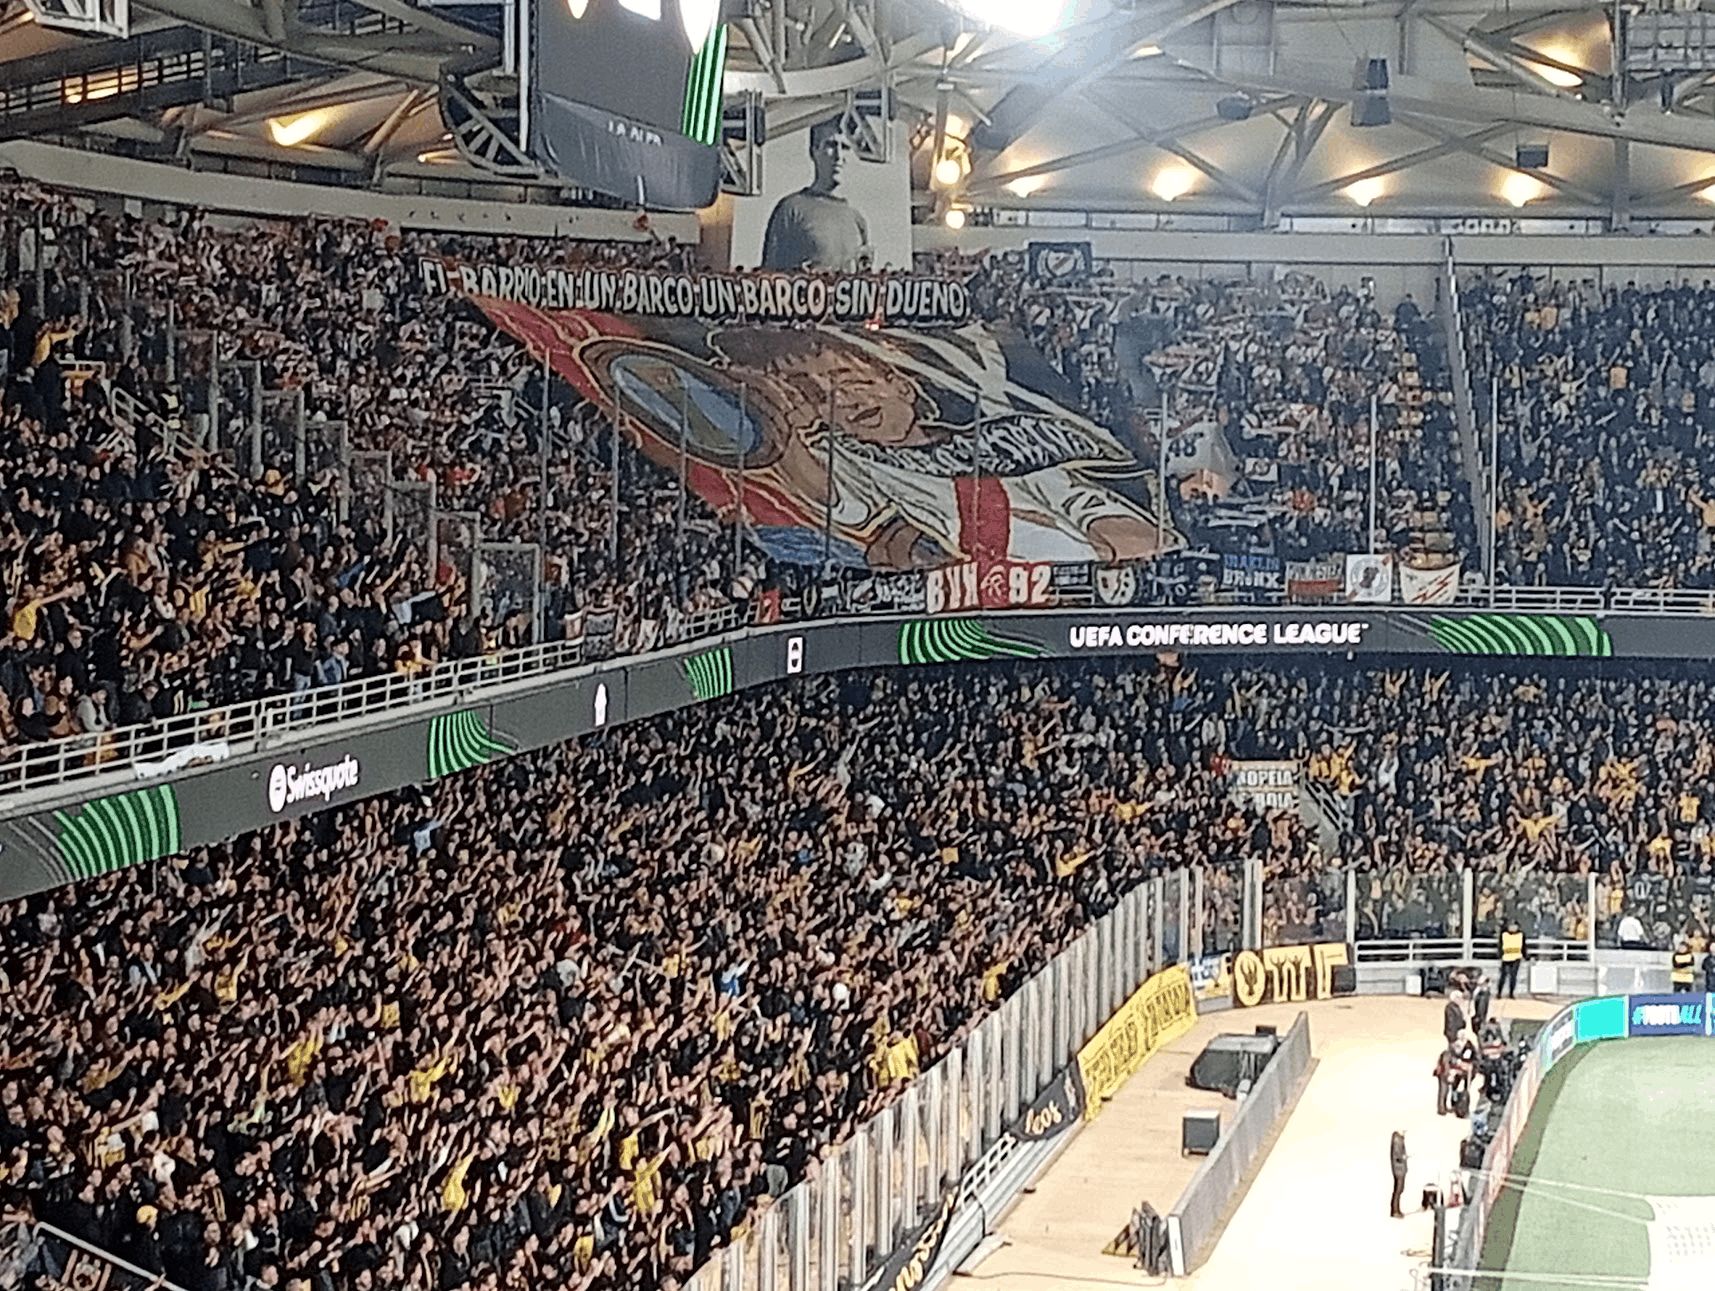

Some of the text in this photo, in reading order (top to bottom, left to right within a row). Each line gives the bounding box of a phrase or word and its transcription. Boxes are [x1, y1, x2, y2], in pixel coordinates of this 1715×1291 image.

[459, 264, 541, 308] BARRIO
[584, 270, 617, 311] UN
[622, 271, 693, 314] BARCO
[700, 277, 738, 315] UN
[740, 277, 827, 318] BARCO
[834, 278, 878, 317] SIN
[1008, 564, 1052, 605] 92
[1069, 622, 1361, 648] UEFA CONFERENCE LEAGUE
[286, 753, 359, 804] Swissquote
